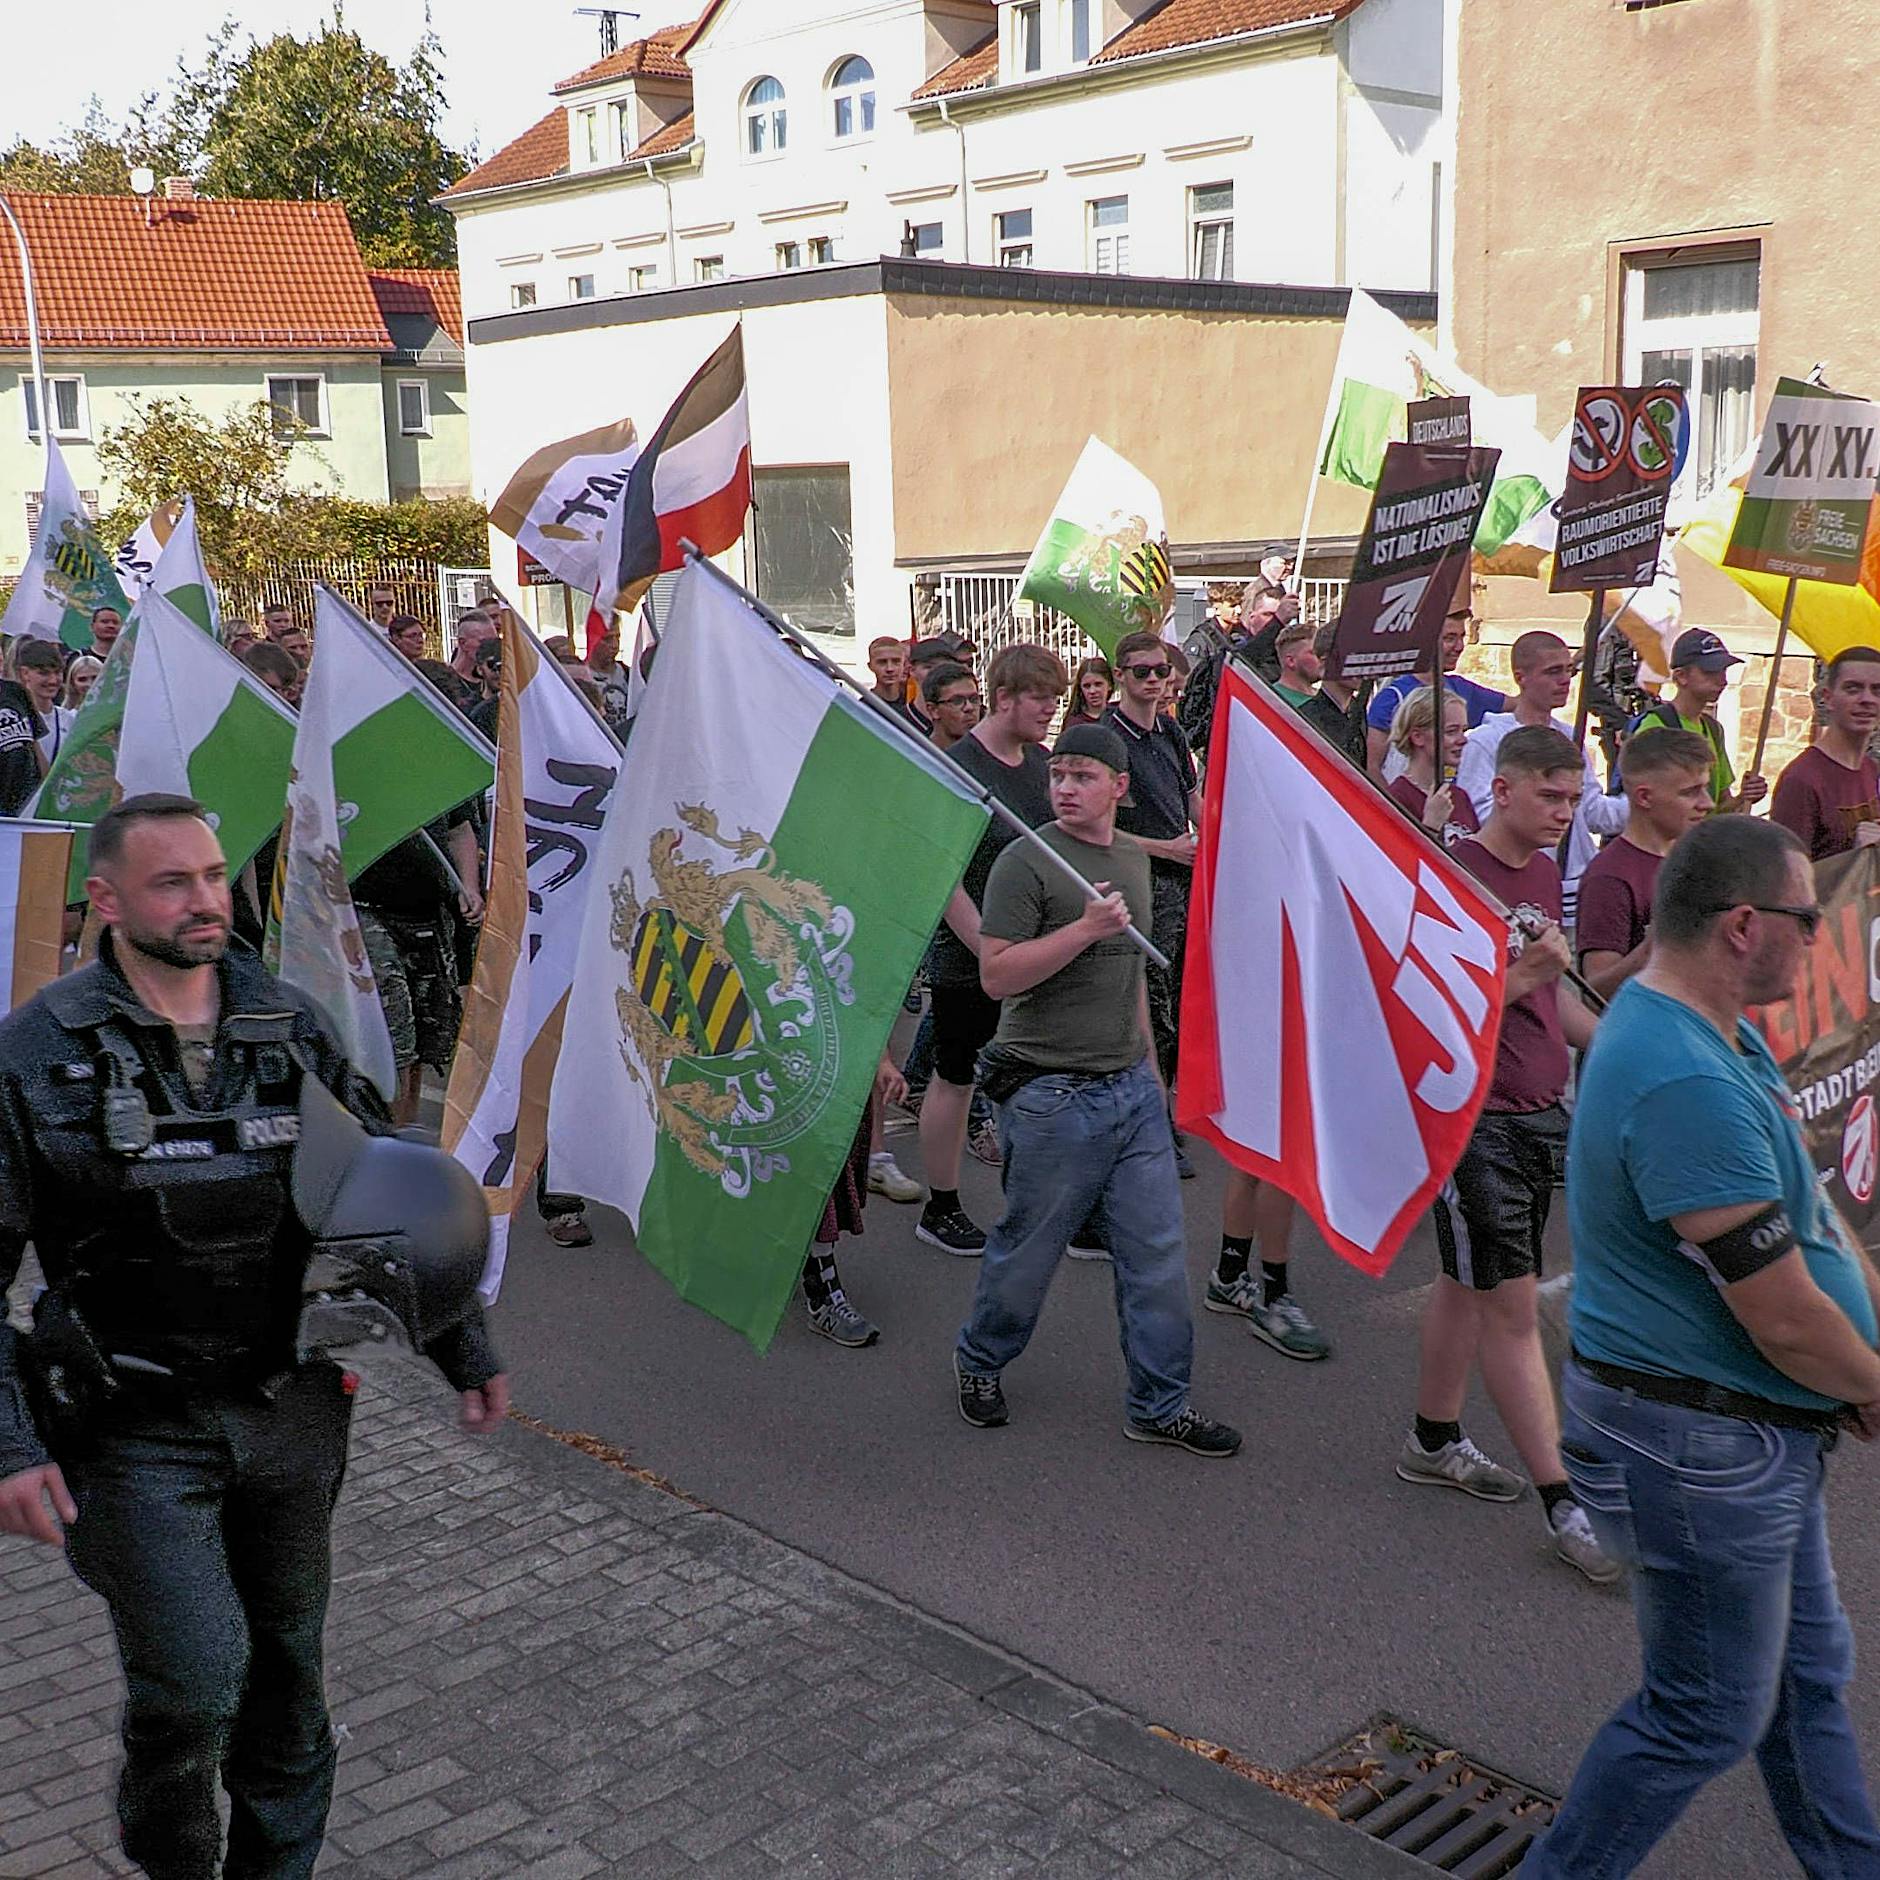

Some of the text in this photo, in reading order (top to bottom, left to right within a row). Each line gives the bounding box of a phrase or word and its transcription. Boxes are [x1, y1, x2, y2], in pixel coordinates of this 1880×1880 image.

[1412, 414, 1468, 443] DEUTSCHLANDS
[1374, 481, 1482, 534] NATIONALISMUS
[1561, 494, 1664, 543] RAUMORIENTIERTE
[1817, 508, 1846, 529] FREIE
[1372, 514, 1473, 566] IST DIE LÖSUNG!
[1560, 519, 1664, 569] VOLKSWIRTSCHAFT
[1813, 527, 1859, 550] SACHSEN
[1388, 611, 1418, 633] JN
